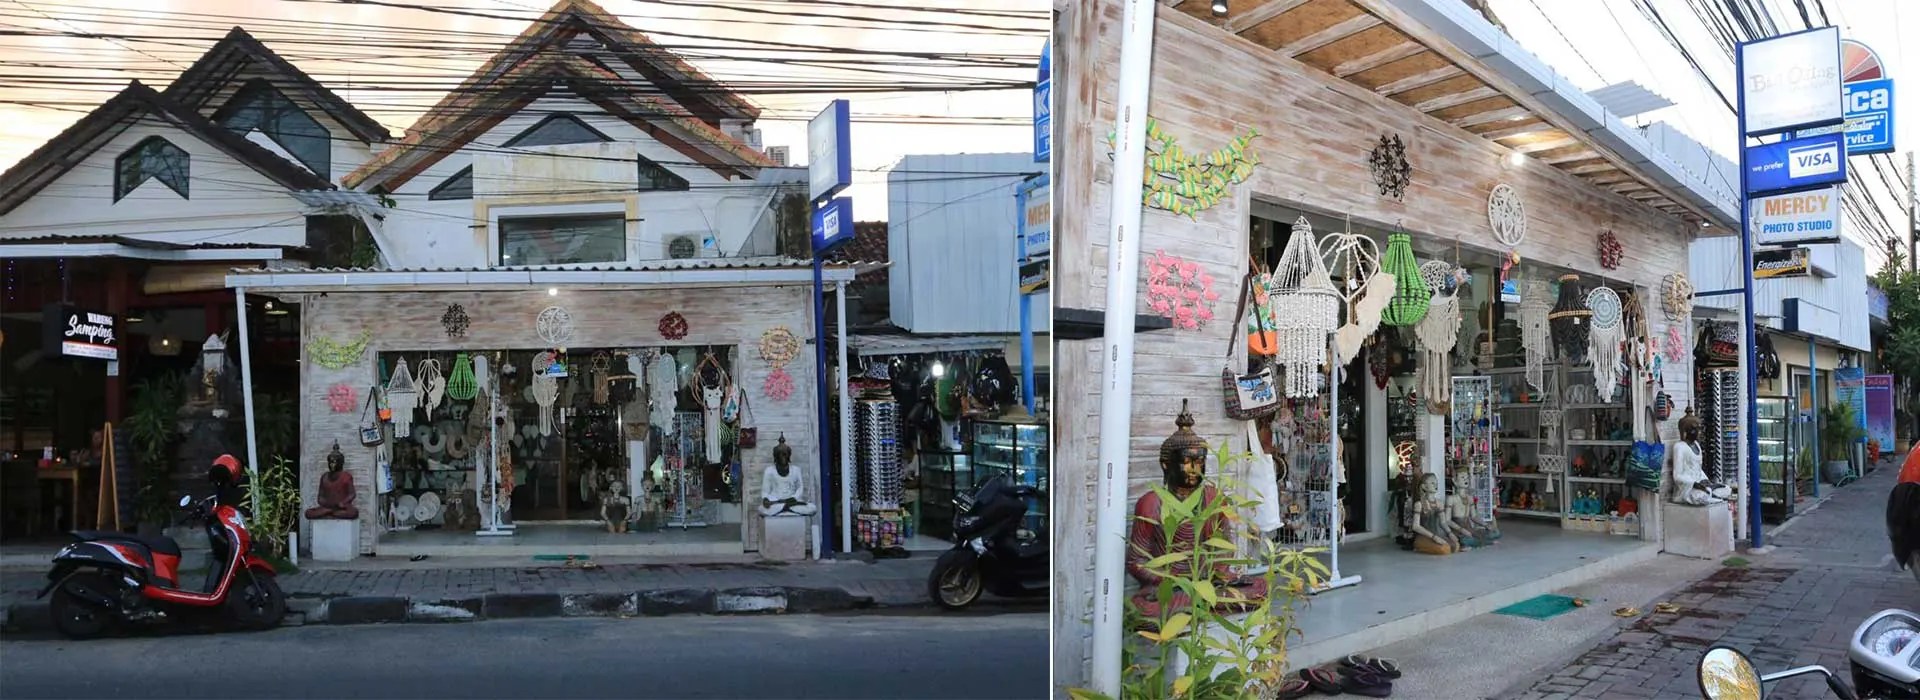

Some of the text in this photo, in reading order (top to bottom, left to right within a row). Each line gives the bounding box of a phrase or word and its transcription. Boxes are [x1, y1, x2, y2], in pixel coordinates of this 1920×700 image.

[1845, 133, 1874, 144] rvice
[1798, 153, 1832, 168] VISA
[1765, 195, 1829, 216] MERCY
[1763, 220, 1833, 234] PHOTO STUDIO
[65, 314, 115, 344] Samping
